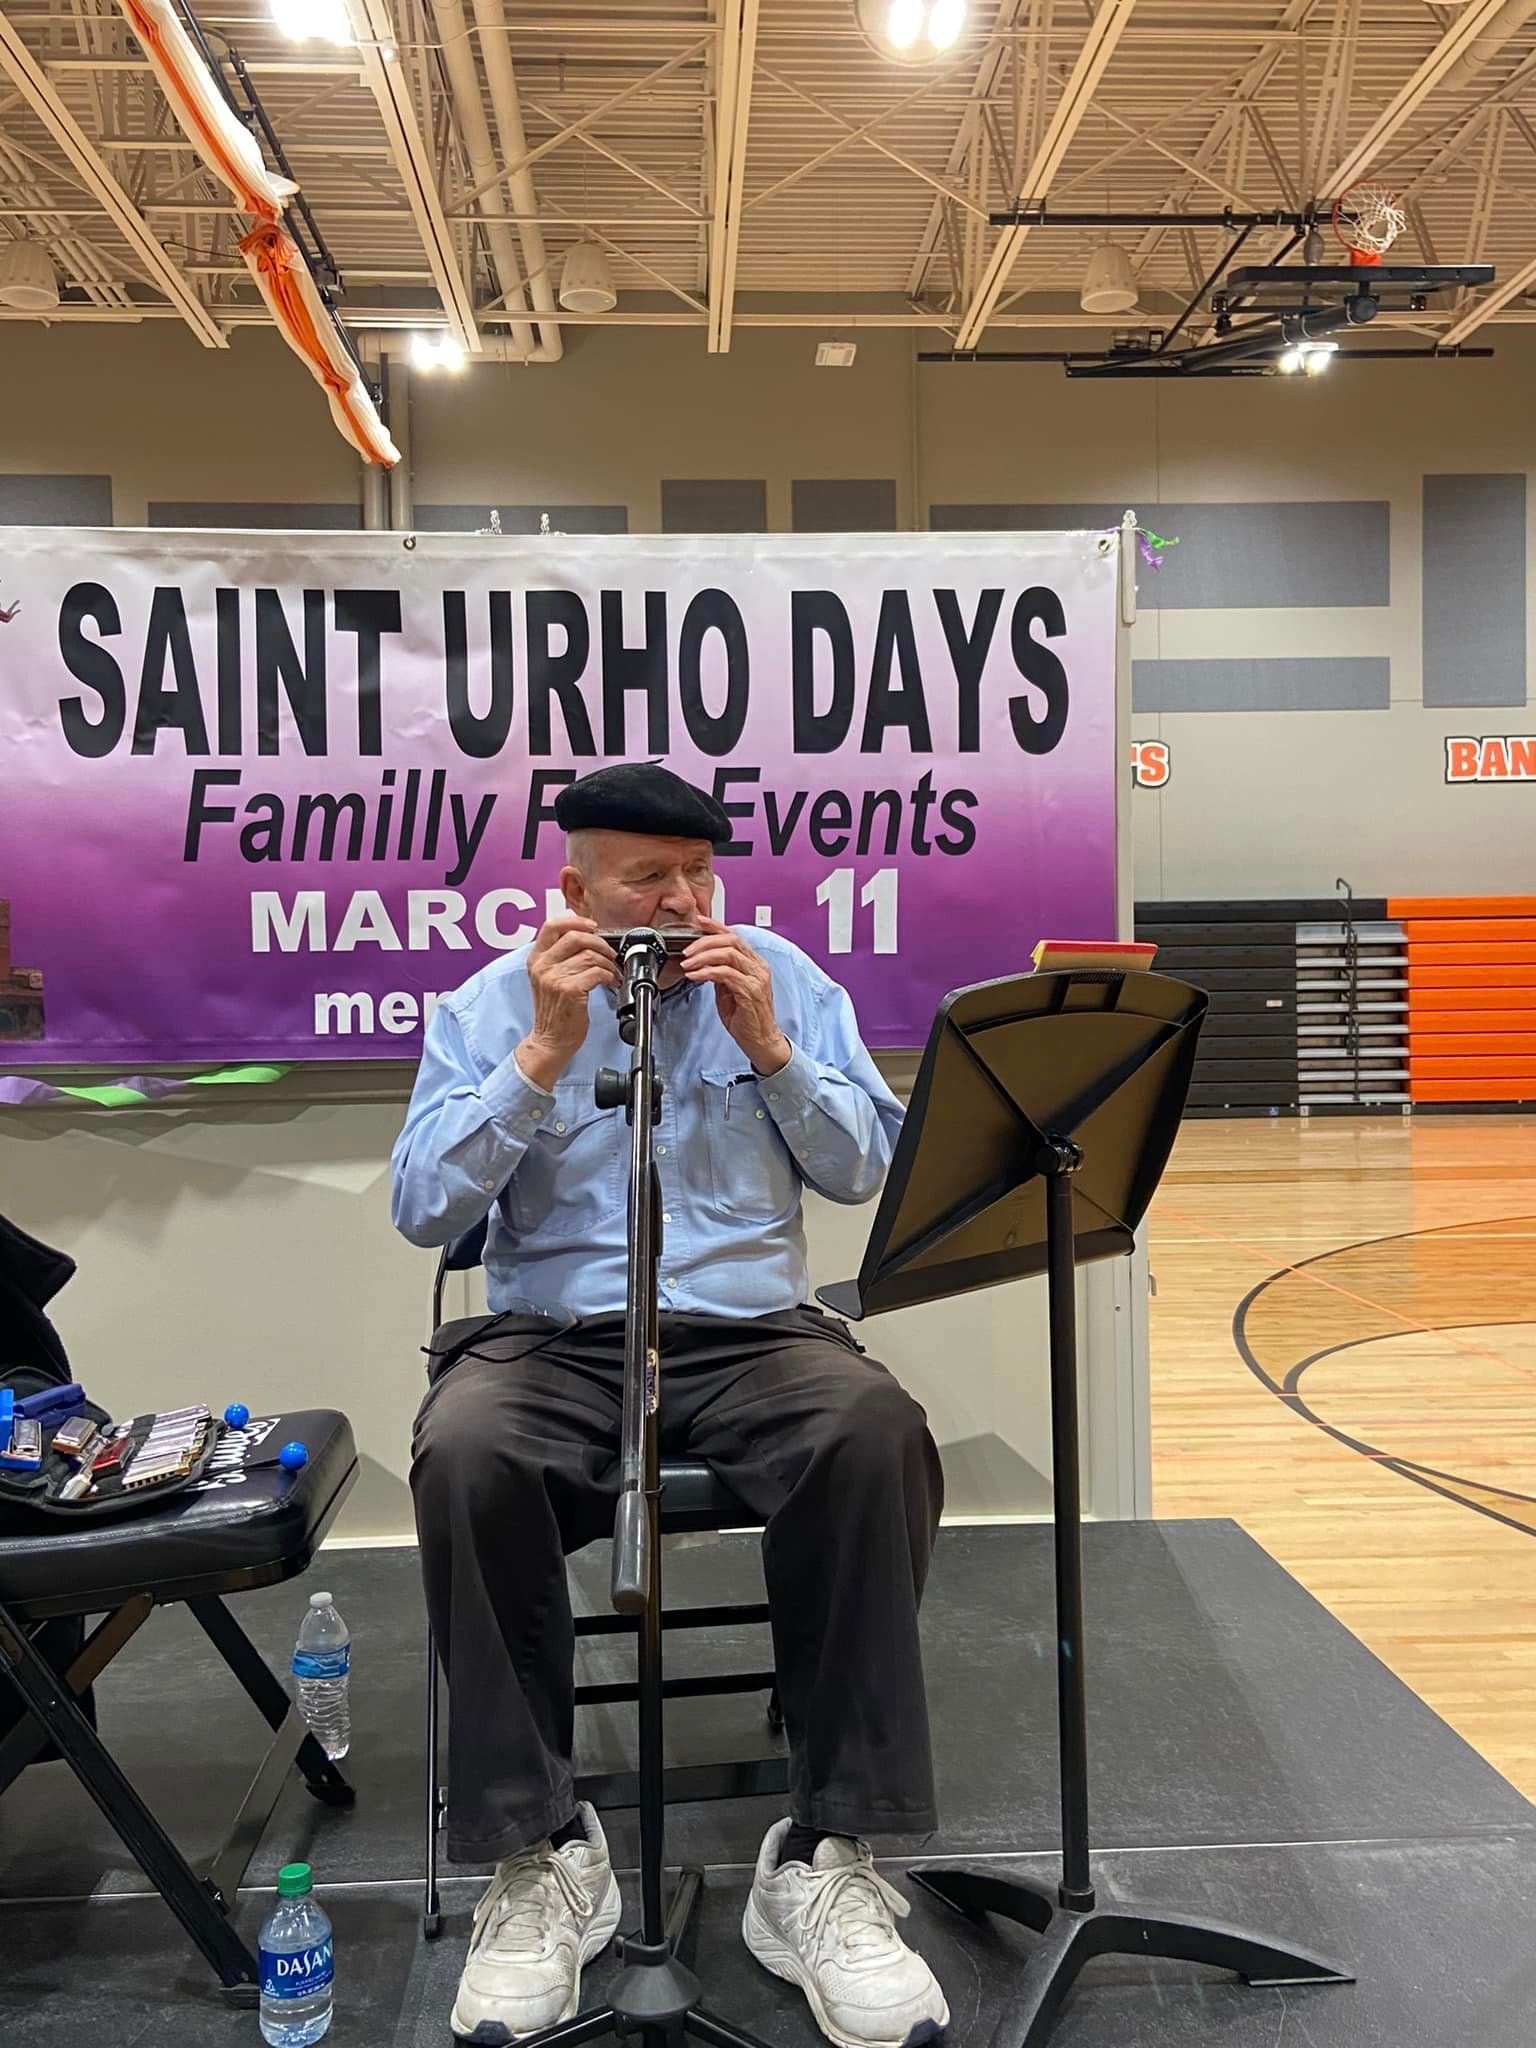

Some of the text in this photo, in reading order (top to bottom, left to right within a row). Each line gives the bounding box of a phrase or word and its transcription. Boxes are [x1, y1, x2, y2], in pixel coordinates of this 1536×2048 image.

[58, 582, 1069, 758] SAINT URHO DAYS
[1131, 739, 1171, 789] S
[183, 768, 497, 886] Familly
[714, 767, 979, 857] Events
[816, 868, 898, 954] 11
